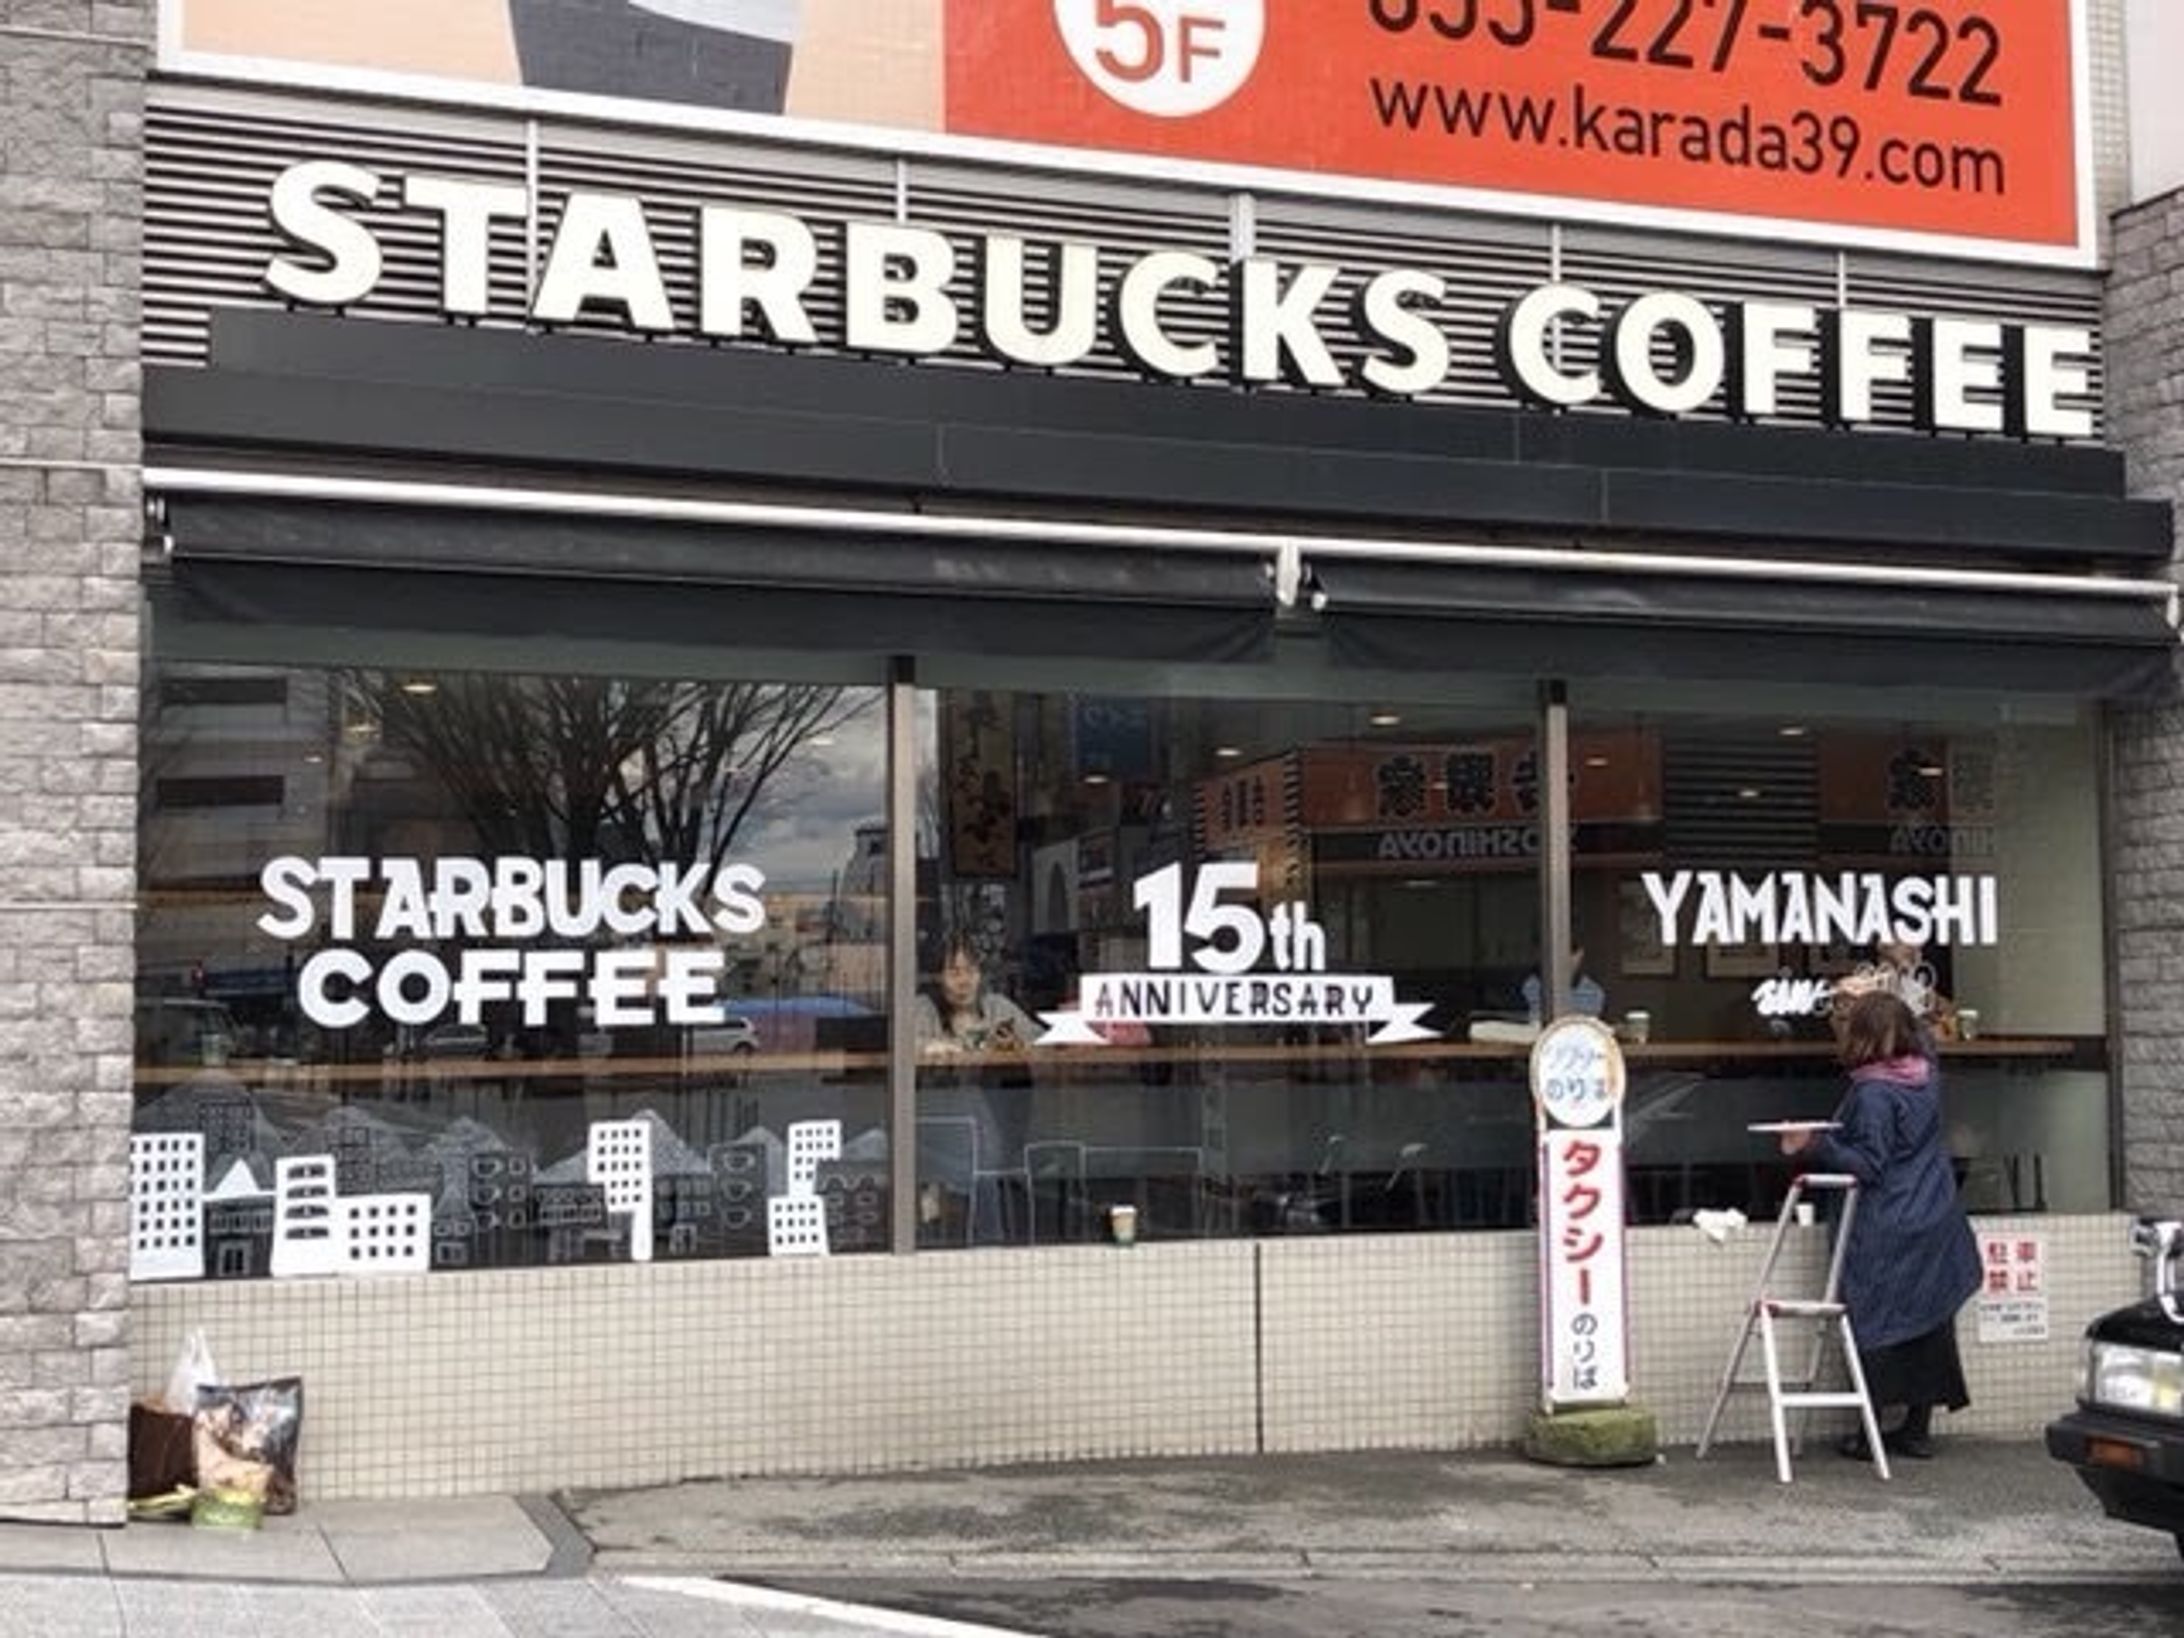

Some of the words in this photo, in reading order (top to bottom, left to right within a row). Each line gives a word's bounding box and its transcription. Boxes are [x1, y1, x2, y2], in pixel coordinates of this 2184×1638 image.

[1095, 0, 1226, 83] 5F
[1371, 78, 2006, 195] www.karada39.com
[264, 160, 1451, 397] STARBUCKS
[1506, 282, 2093, 437] COFFEE
[257, 856, 766, 939] STARBUCKS
[1133, 861, 1326, 973] 15th
[1641, 871, 1997, 945] YAMANASHI
[299, 948, 726, 1028] COFFEE
[1095, 979, 1374, 1017] ANNIVERSARY
